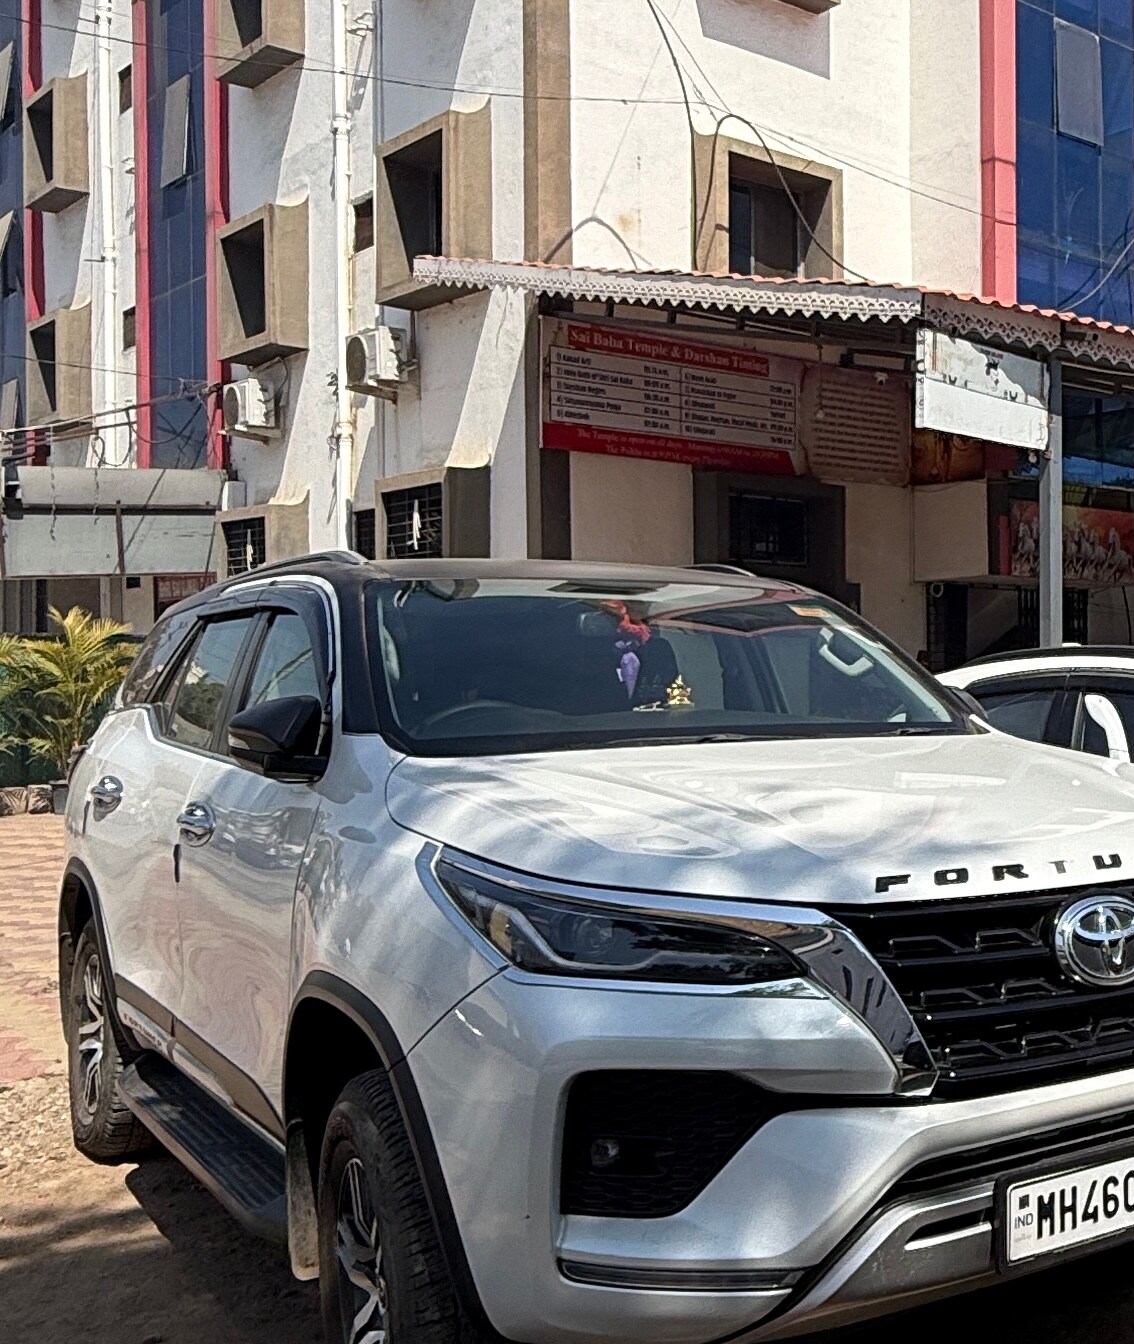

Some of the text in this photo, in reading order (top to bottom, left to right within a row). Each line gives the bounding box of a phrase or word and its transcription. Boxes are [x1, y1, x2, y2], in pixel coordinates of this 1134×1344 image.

[570, 327, 591, 344] Sai
[593, 332, 624, 352] Baba
[626, 338, 669, 357] Temple
[670, 346, 682, 359] &
[685, 348, 730, 367] Darshan
[1014, 1212, 1034, 1229] IND
